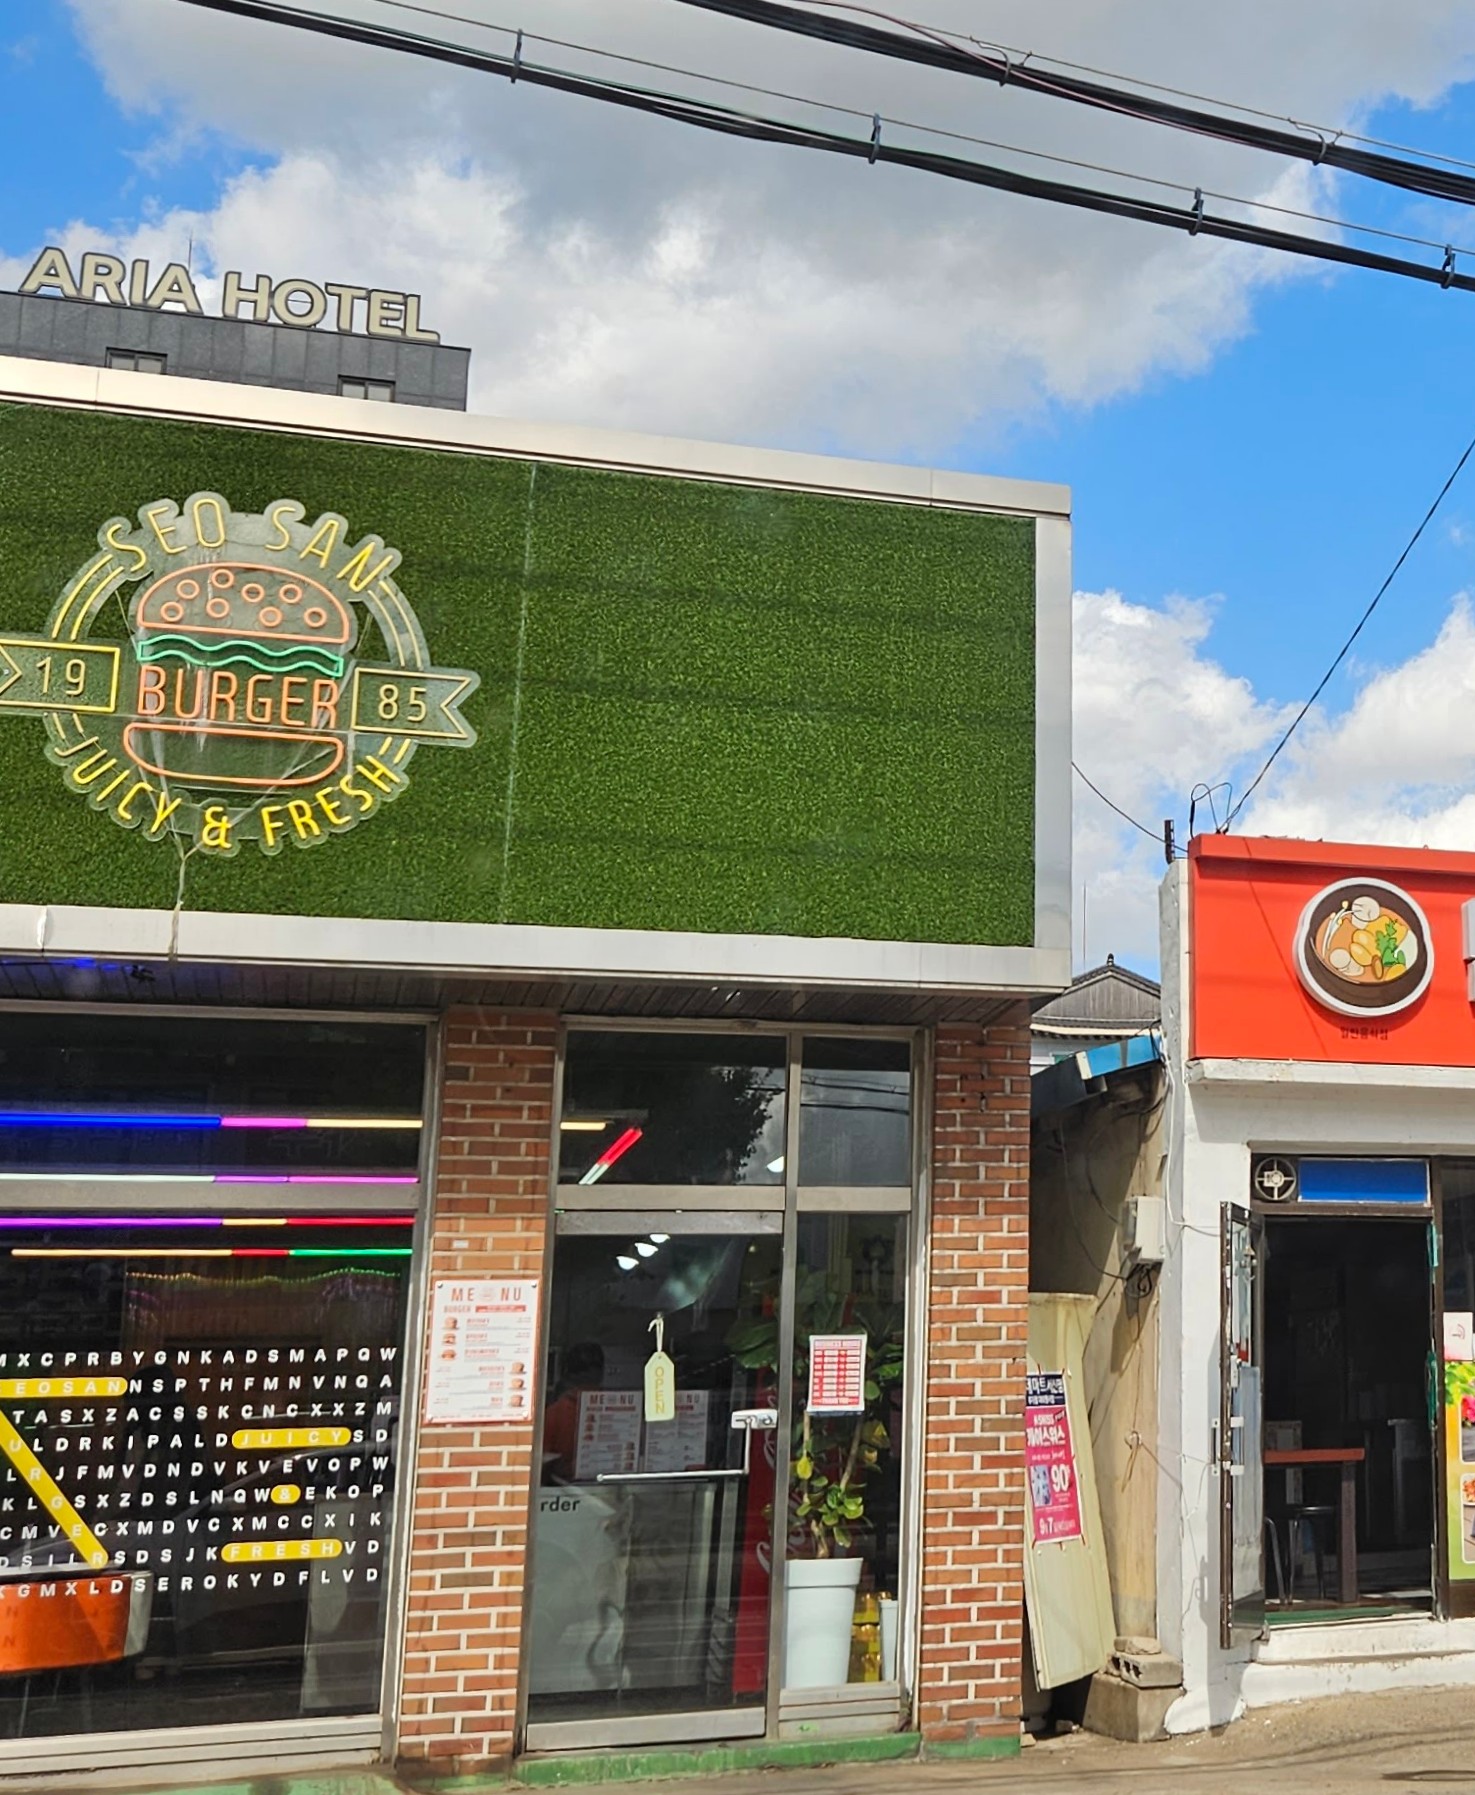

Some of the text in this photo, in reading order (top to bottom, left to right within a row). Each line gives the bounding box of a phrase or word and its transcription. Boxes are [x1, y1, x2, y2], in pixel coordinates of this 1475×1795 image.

[18, 246, 441, 344] ARIA HOTEL
[106, 497, 395, 593] SEO SAN
[35, 657, 88, 696] 19
[136, 664, 339, 729] BURGER
[377, 681, 428, 722] 85
[54, 735, 402, 851] JUICY & FRESH
[655, 1366, 665, 1415] OPEN
[540, 1496, 581, 1512] rder
